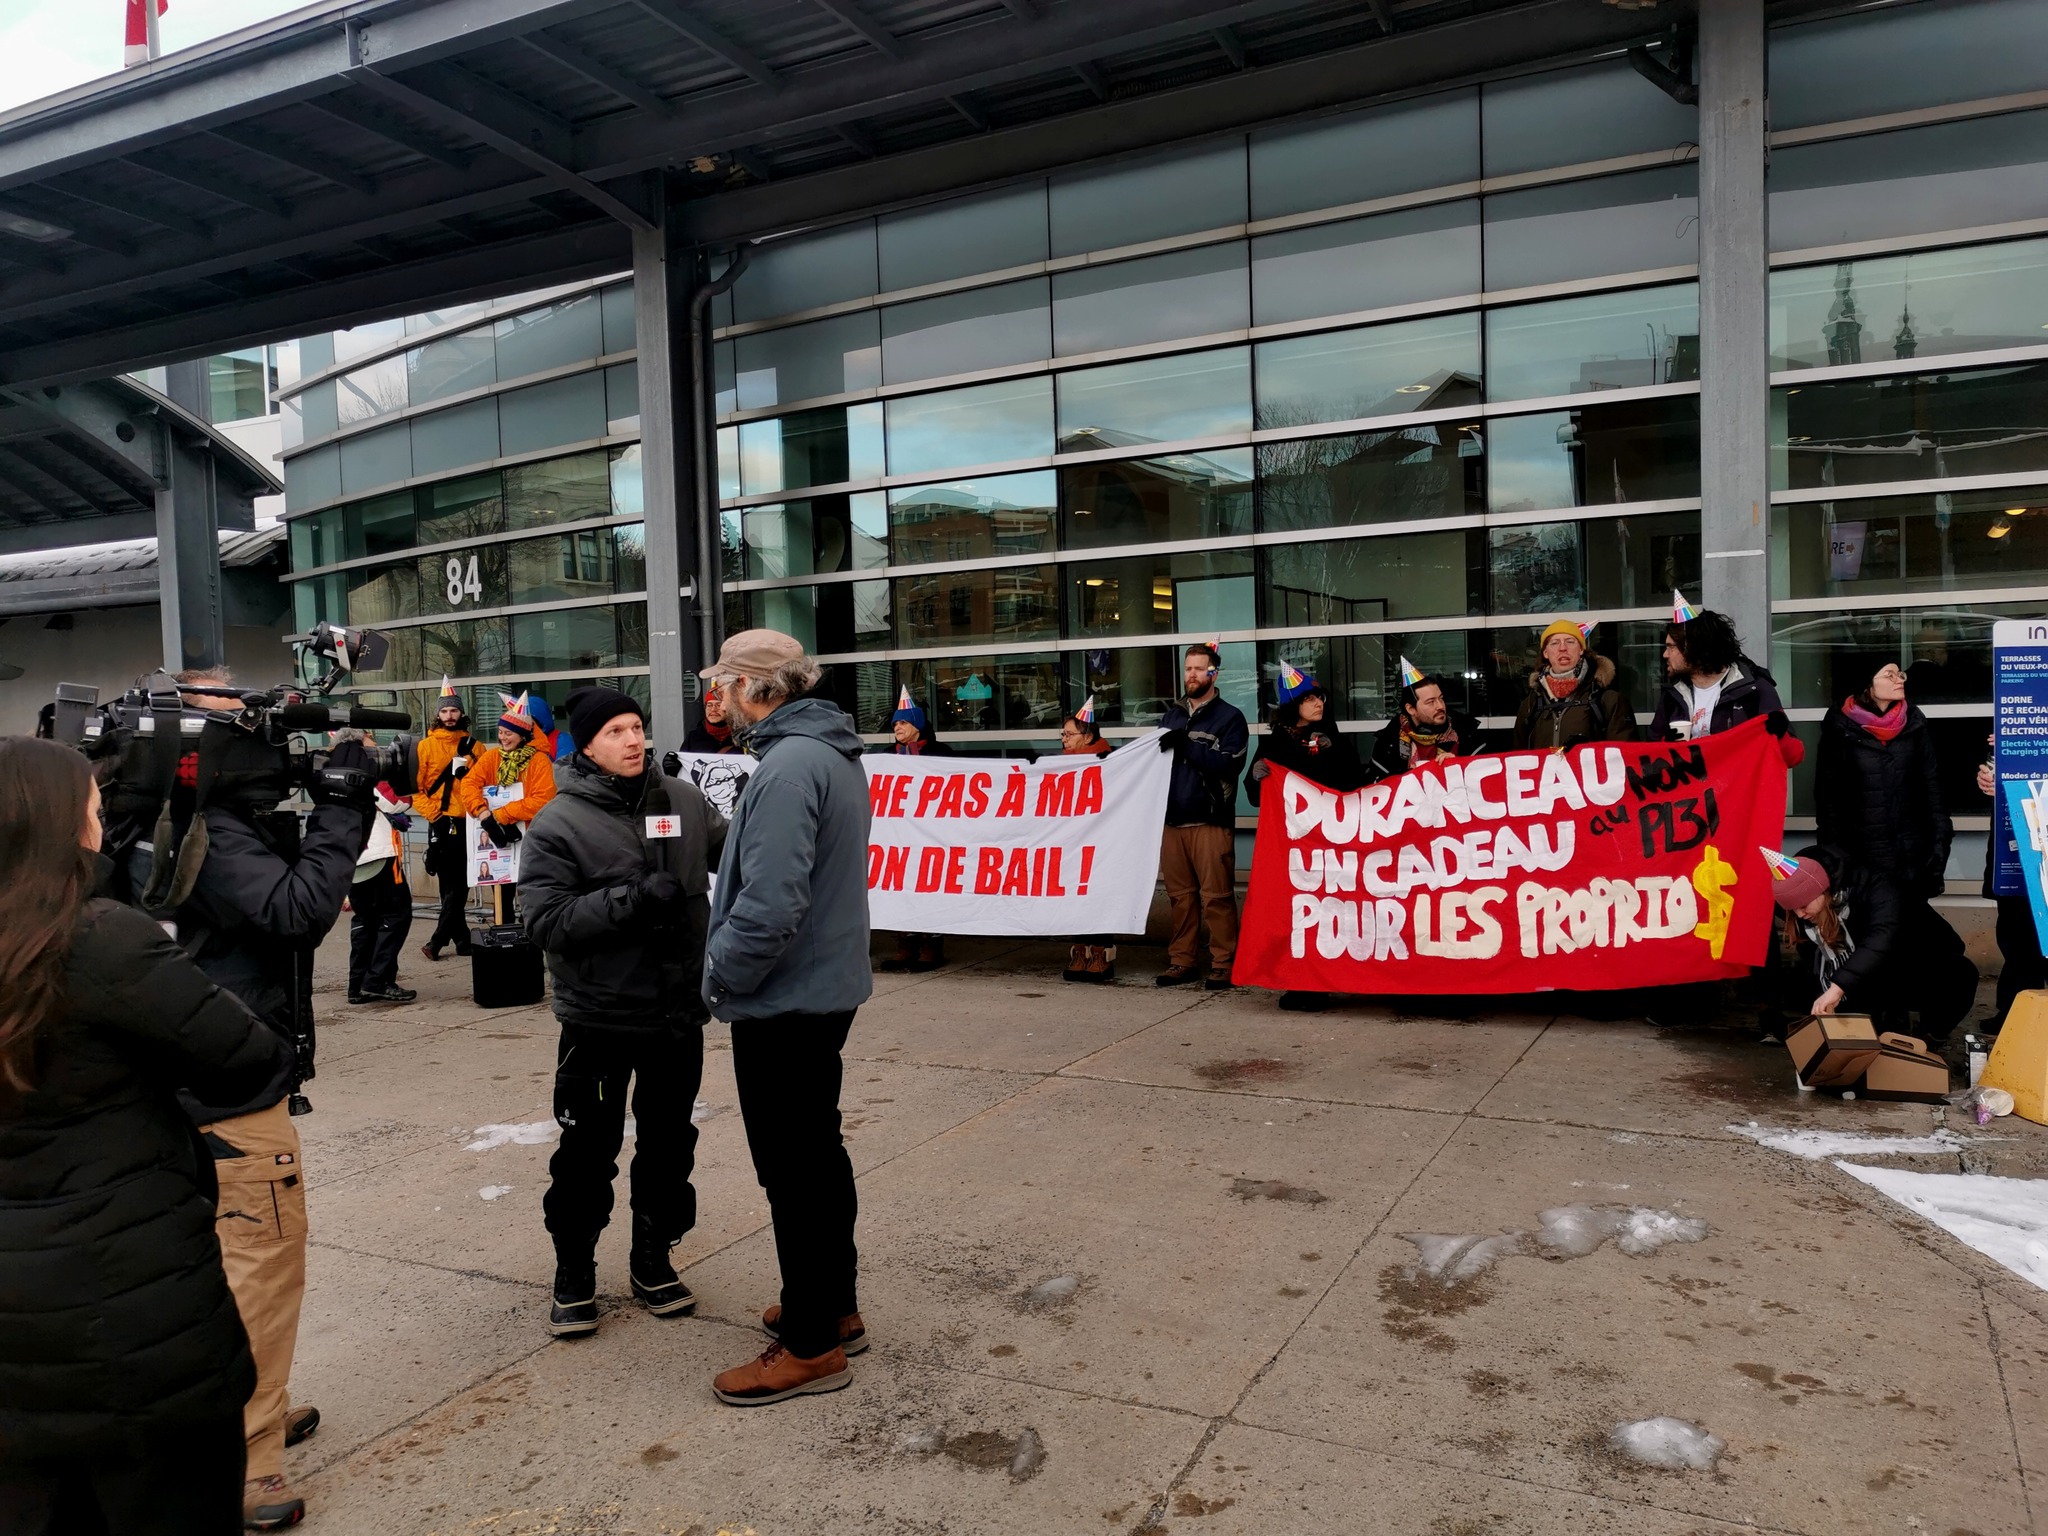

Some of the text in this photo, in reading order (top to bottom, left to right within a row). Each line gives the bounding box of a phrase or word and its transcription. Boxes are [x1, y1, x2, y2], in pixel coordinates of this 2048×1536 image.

[446, 555, 482, 605] 84
[2001, 696, 2033, 704] BORNE
[2001, 715, 2048, 725] POUR VÉH
[2016, 706, 2048, 714] RECHA
[1626, 745, 1707, 800] NON
[2001, 748, 2038, 756] Charging
[914, 772, 992, 818] PAS
[995, 765, 1026, 818] À
[1035, 765, 1103, 817] MA
[1283, 747, 1626, 844] DURANCEAU
[1590, 804, 1631, 836] au
[915, 846, 966, 894] DE
[974, 846, 1065, 896] BAIL
[1288, 820, 1575, 899] UN CADEAU
[1291, 893, 1409, 961] POUR
[1414, 886, 1508, 960] LES
